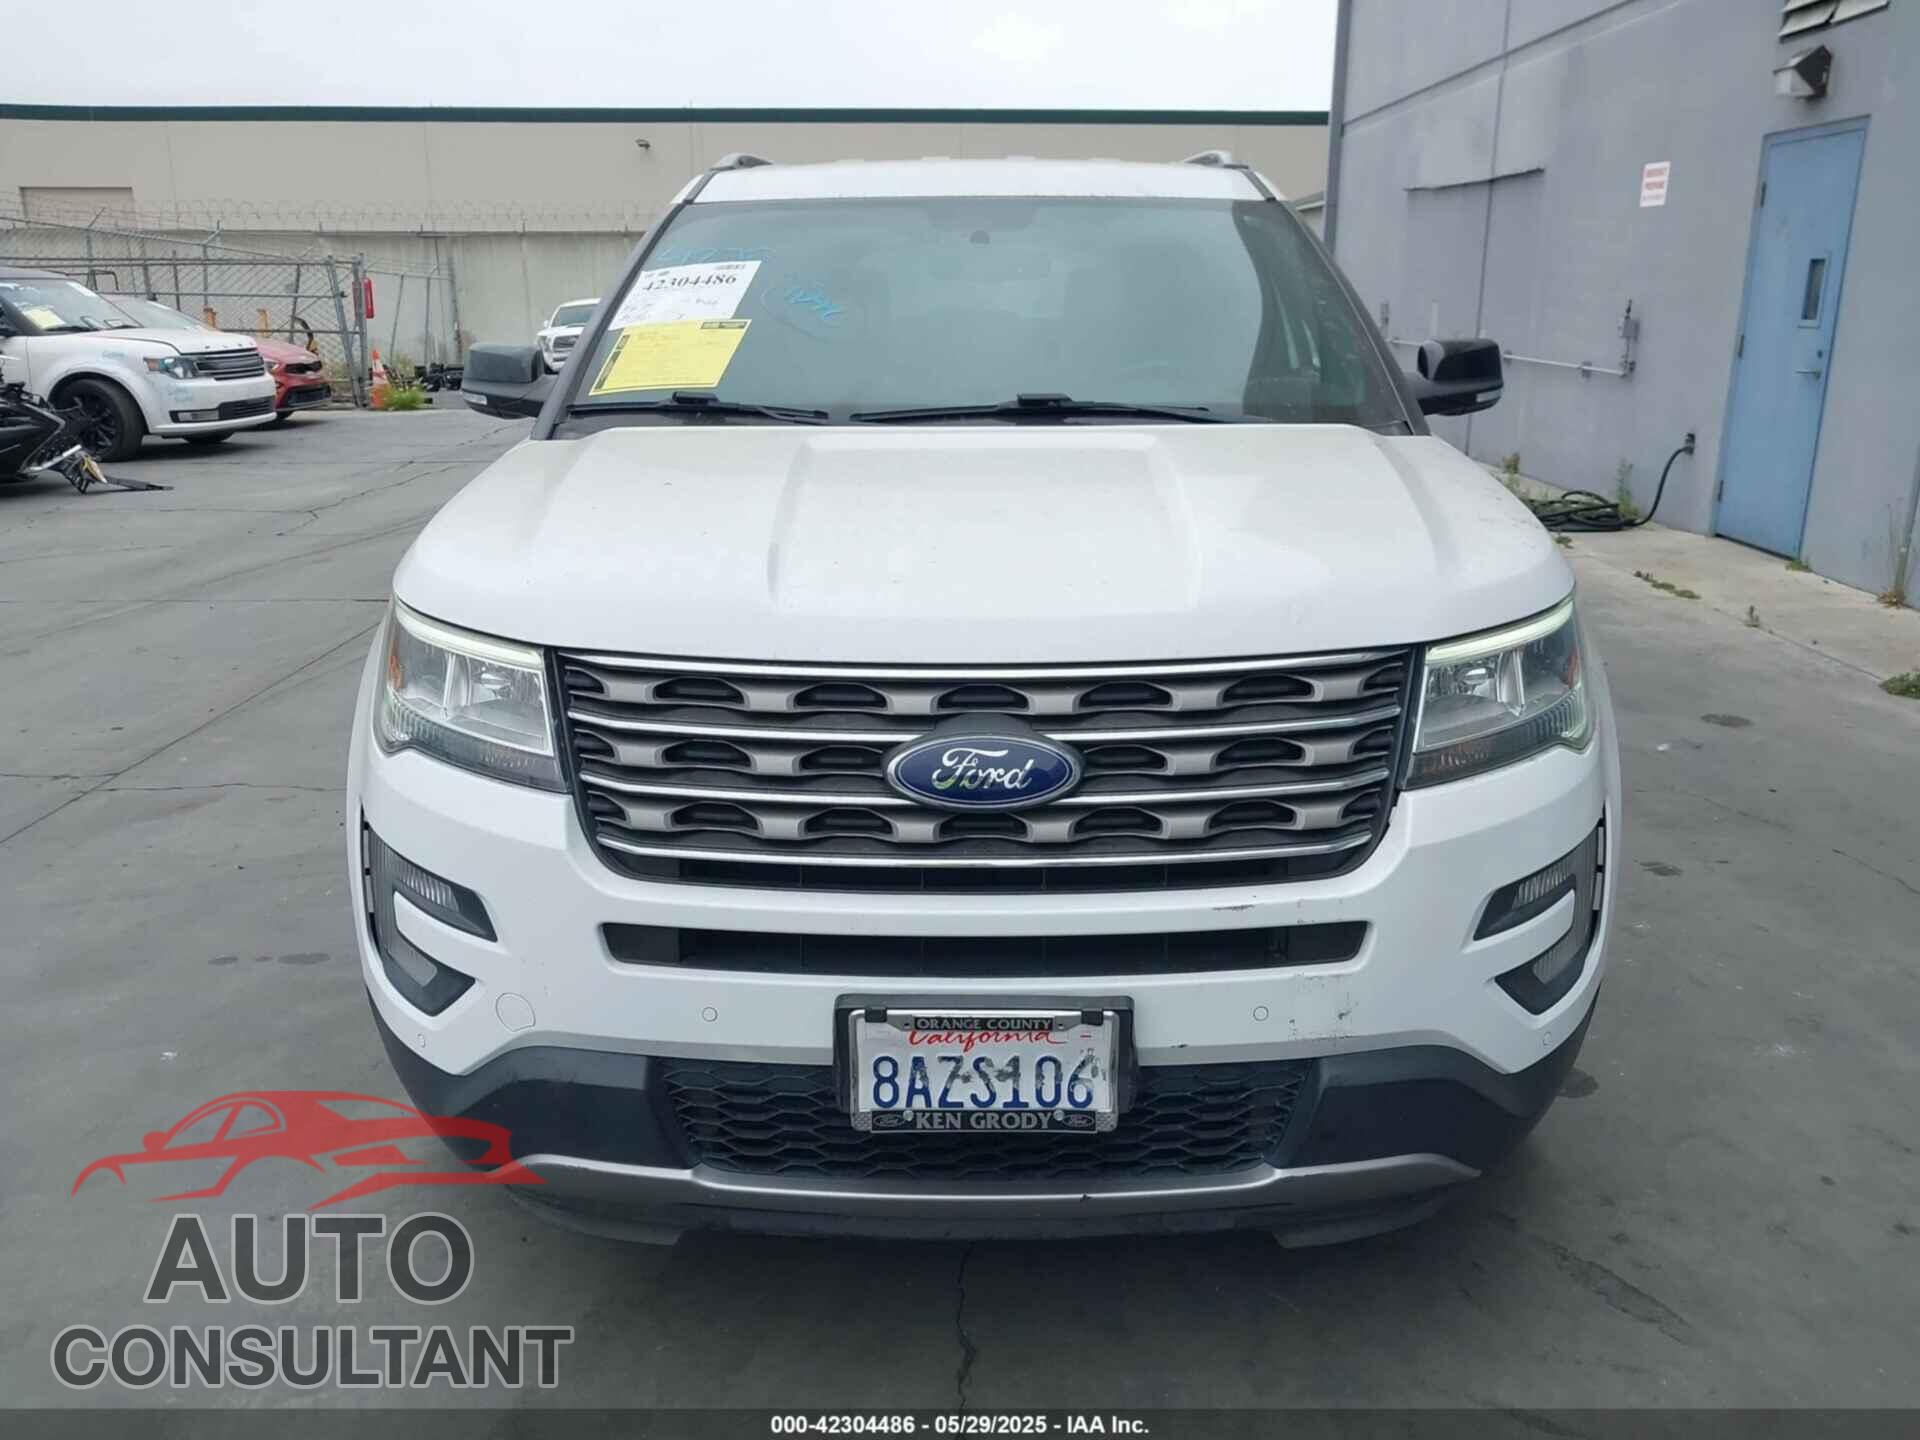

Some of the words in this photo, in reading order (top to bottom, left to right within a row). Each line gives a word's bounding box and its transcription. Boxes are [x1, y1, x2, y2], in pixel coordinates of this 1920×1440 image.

[642, 273, 737, 291] 42304486
[931, 747, 1034, 789] Ford
[916, 1017, 980, 1031] ORANGE
[986, 1017, 1051, 1031] COUNTY
[909, 1030, 1067, 1052] California
[873, 1055, 1094, 1109] 8AZS106
[915, 1112, 965, 1129] KEN
[970, 1112, 1052, 1129] GRODY
